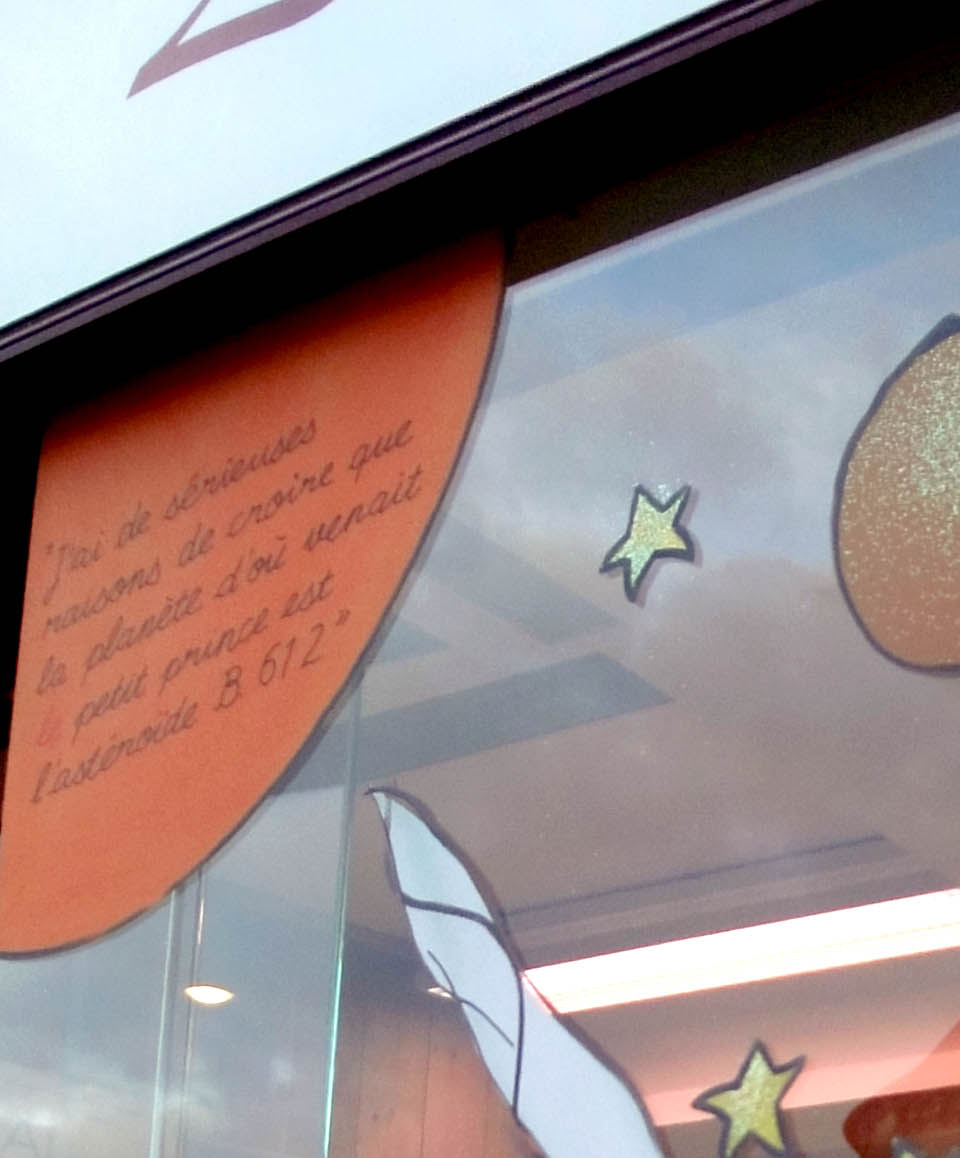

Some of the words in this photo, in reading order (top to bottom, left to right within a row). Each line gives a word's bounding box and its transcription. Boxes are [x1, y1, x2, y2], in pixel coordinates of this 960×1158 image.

[43, 557, 161, 639] raisons
[177, 522, 215, 567] de
[226, 461, 334, 538] croire
[349, 420, 414, 484] que
[81, 587, 203, 684] planète
[304, 464, 424, 551] venait
[114, 500, 151, 549] de
[73, 665, 148, 746] petit
[158, 608, 268, 697] prince
[280, 569, 334, 619] est
[213, 665, 242, 711] B
